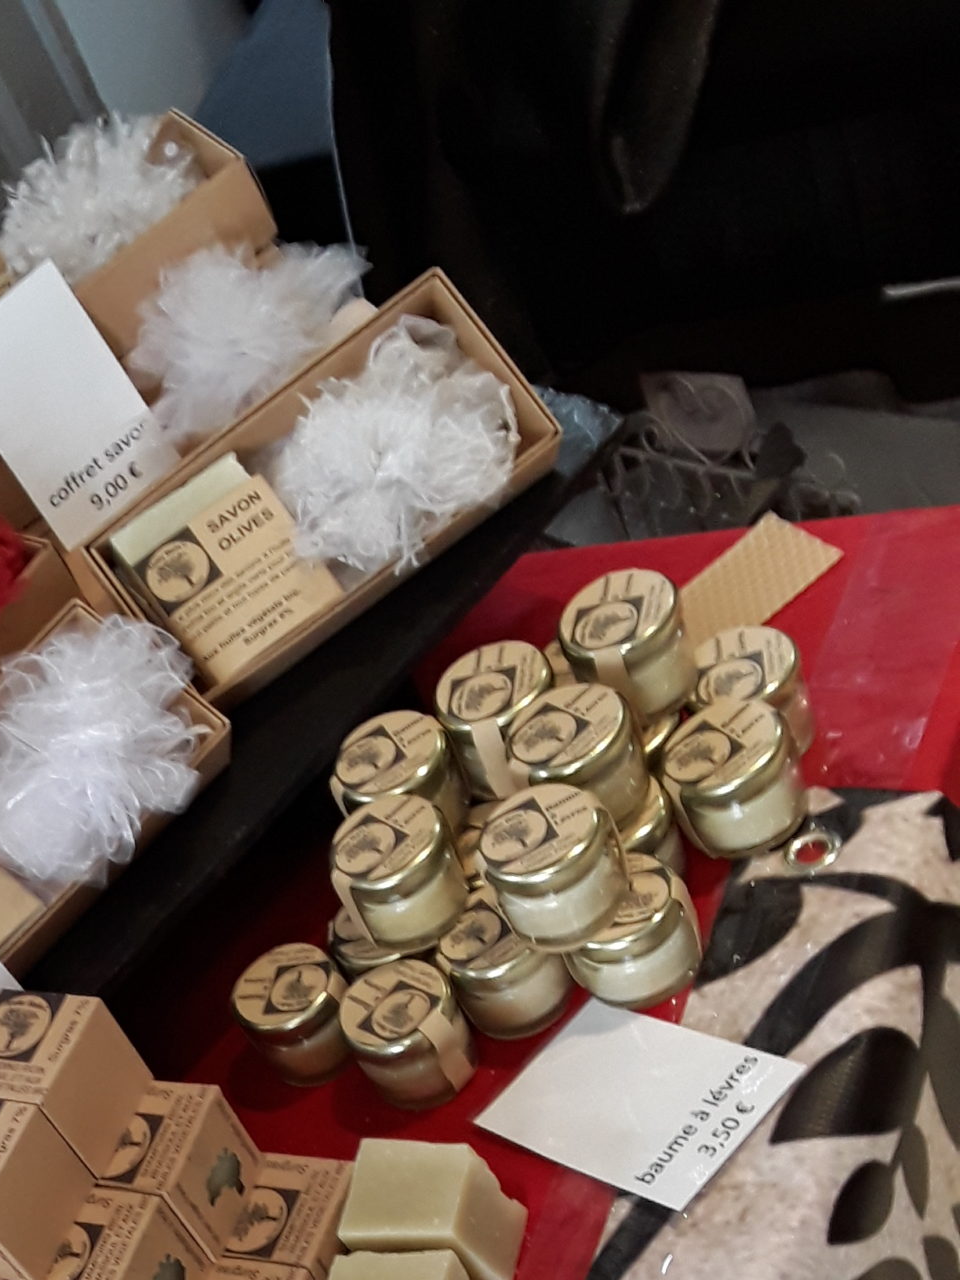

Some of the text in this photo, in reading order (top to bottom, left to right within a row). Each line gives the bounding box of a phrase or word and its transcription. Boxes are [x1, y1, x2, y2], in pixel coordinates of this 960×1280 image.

[49, 457, 104, 508] coffret
[90, 462, 143, 507] 9,00 €
[207, 490, 262, 534] SAVON
[218, 510, 274, 551] OLIVES
[634, 1124, 698, 1185] baume
[690, 1109, 711, 1122] à
[697, 1102, 755, 1158] 3,50 €
